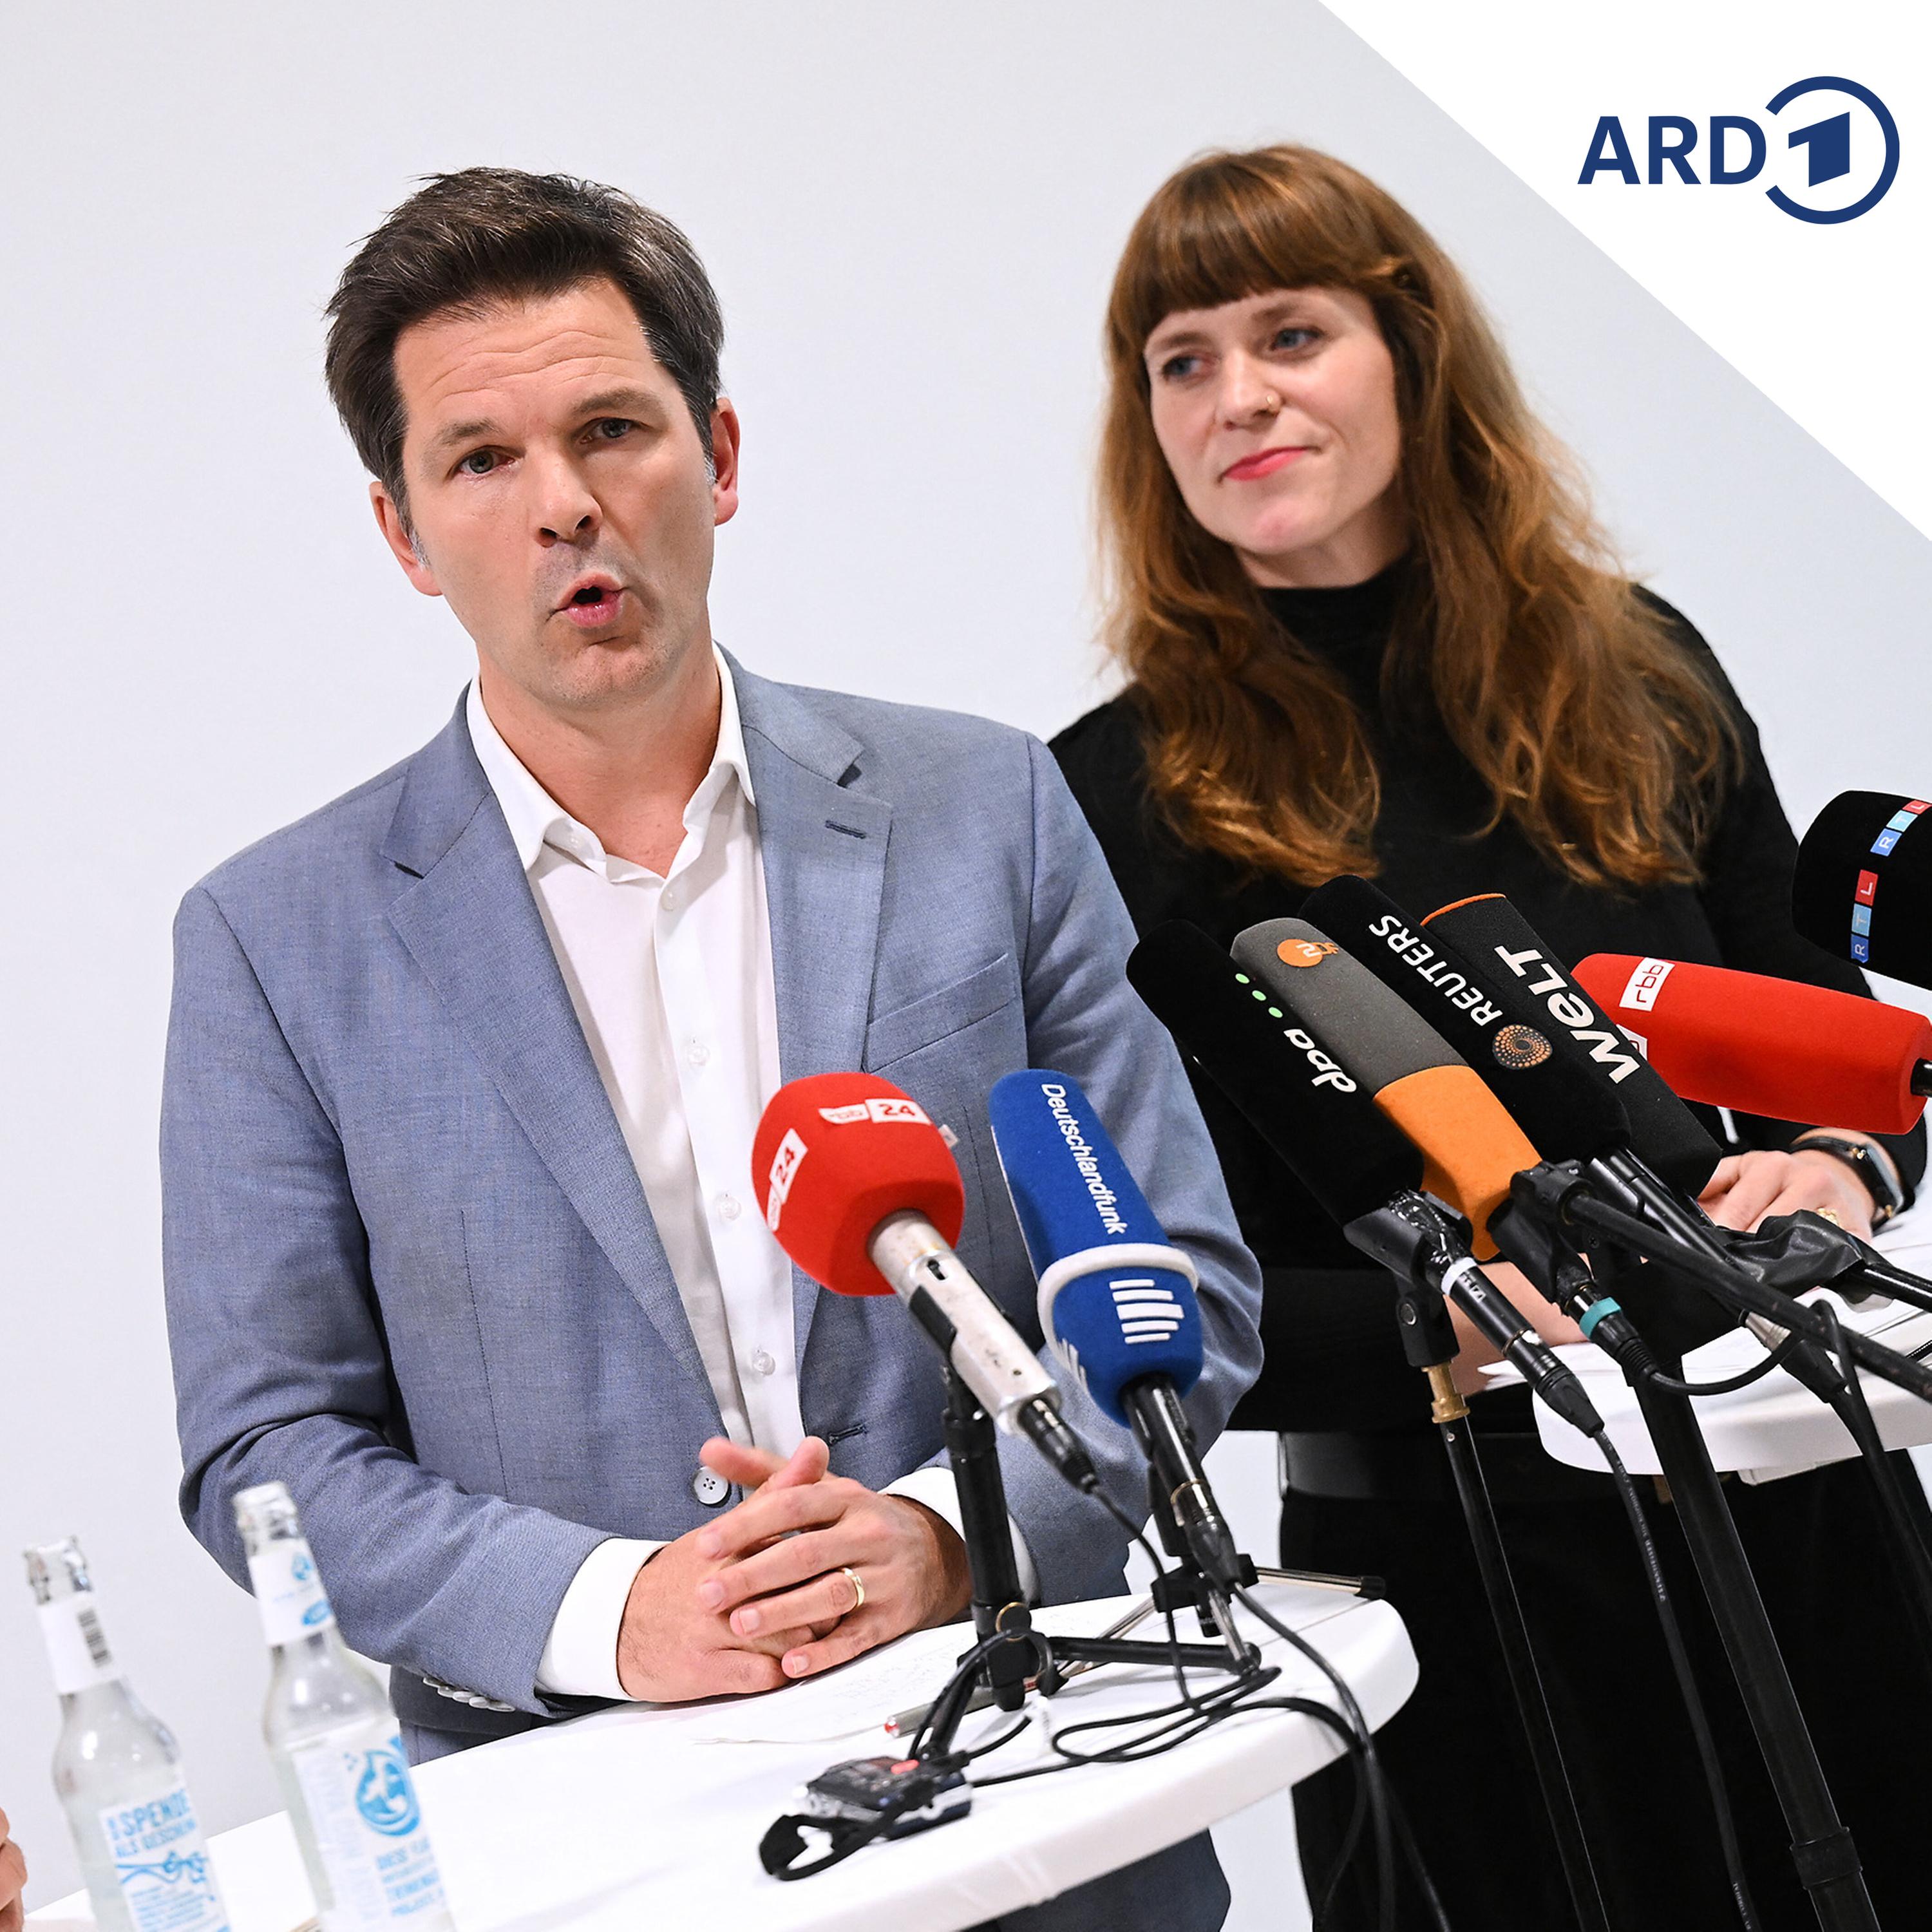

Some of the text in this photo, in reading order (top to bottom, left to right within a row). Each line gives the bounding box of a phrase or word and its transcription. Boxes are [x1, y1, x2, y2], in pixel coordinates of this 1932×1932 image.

[1853, 880, 1875, 957] RTL
[1368, 915, 1503, 1027] REUTERS
[1634, 964, 1664, 1003] rbb
[1283, 1028, 1357, 1092] dpa
[878, 1103, 916, 1117] 24
[775, 1146, 795, 1187] 24
[1041, 1084, 1128, 1235] Deutschlandfunk
